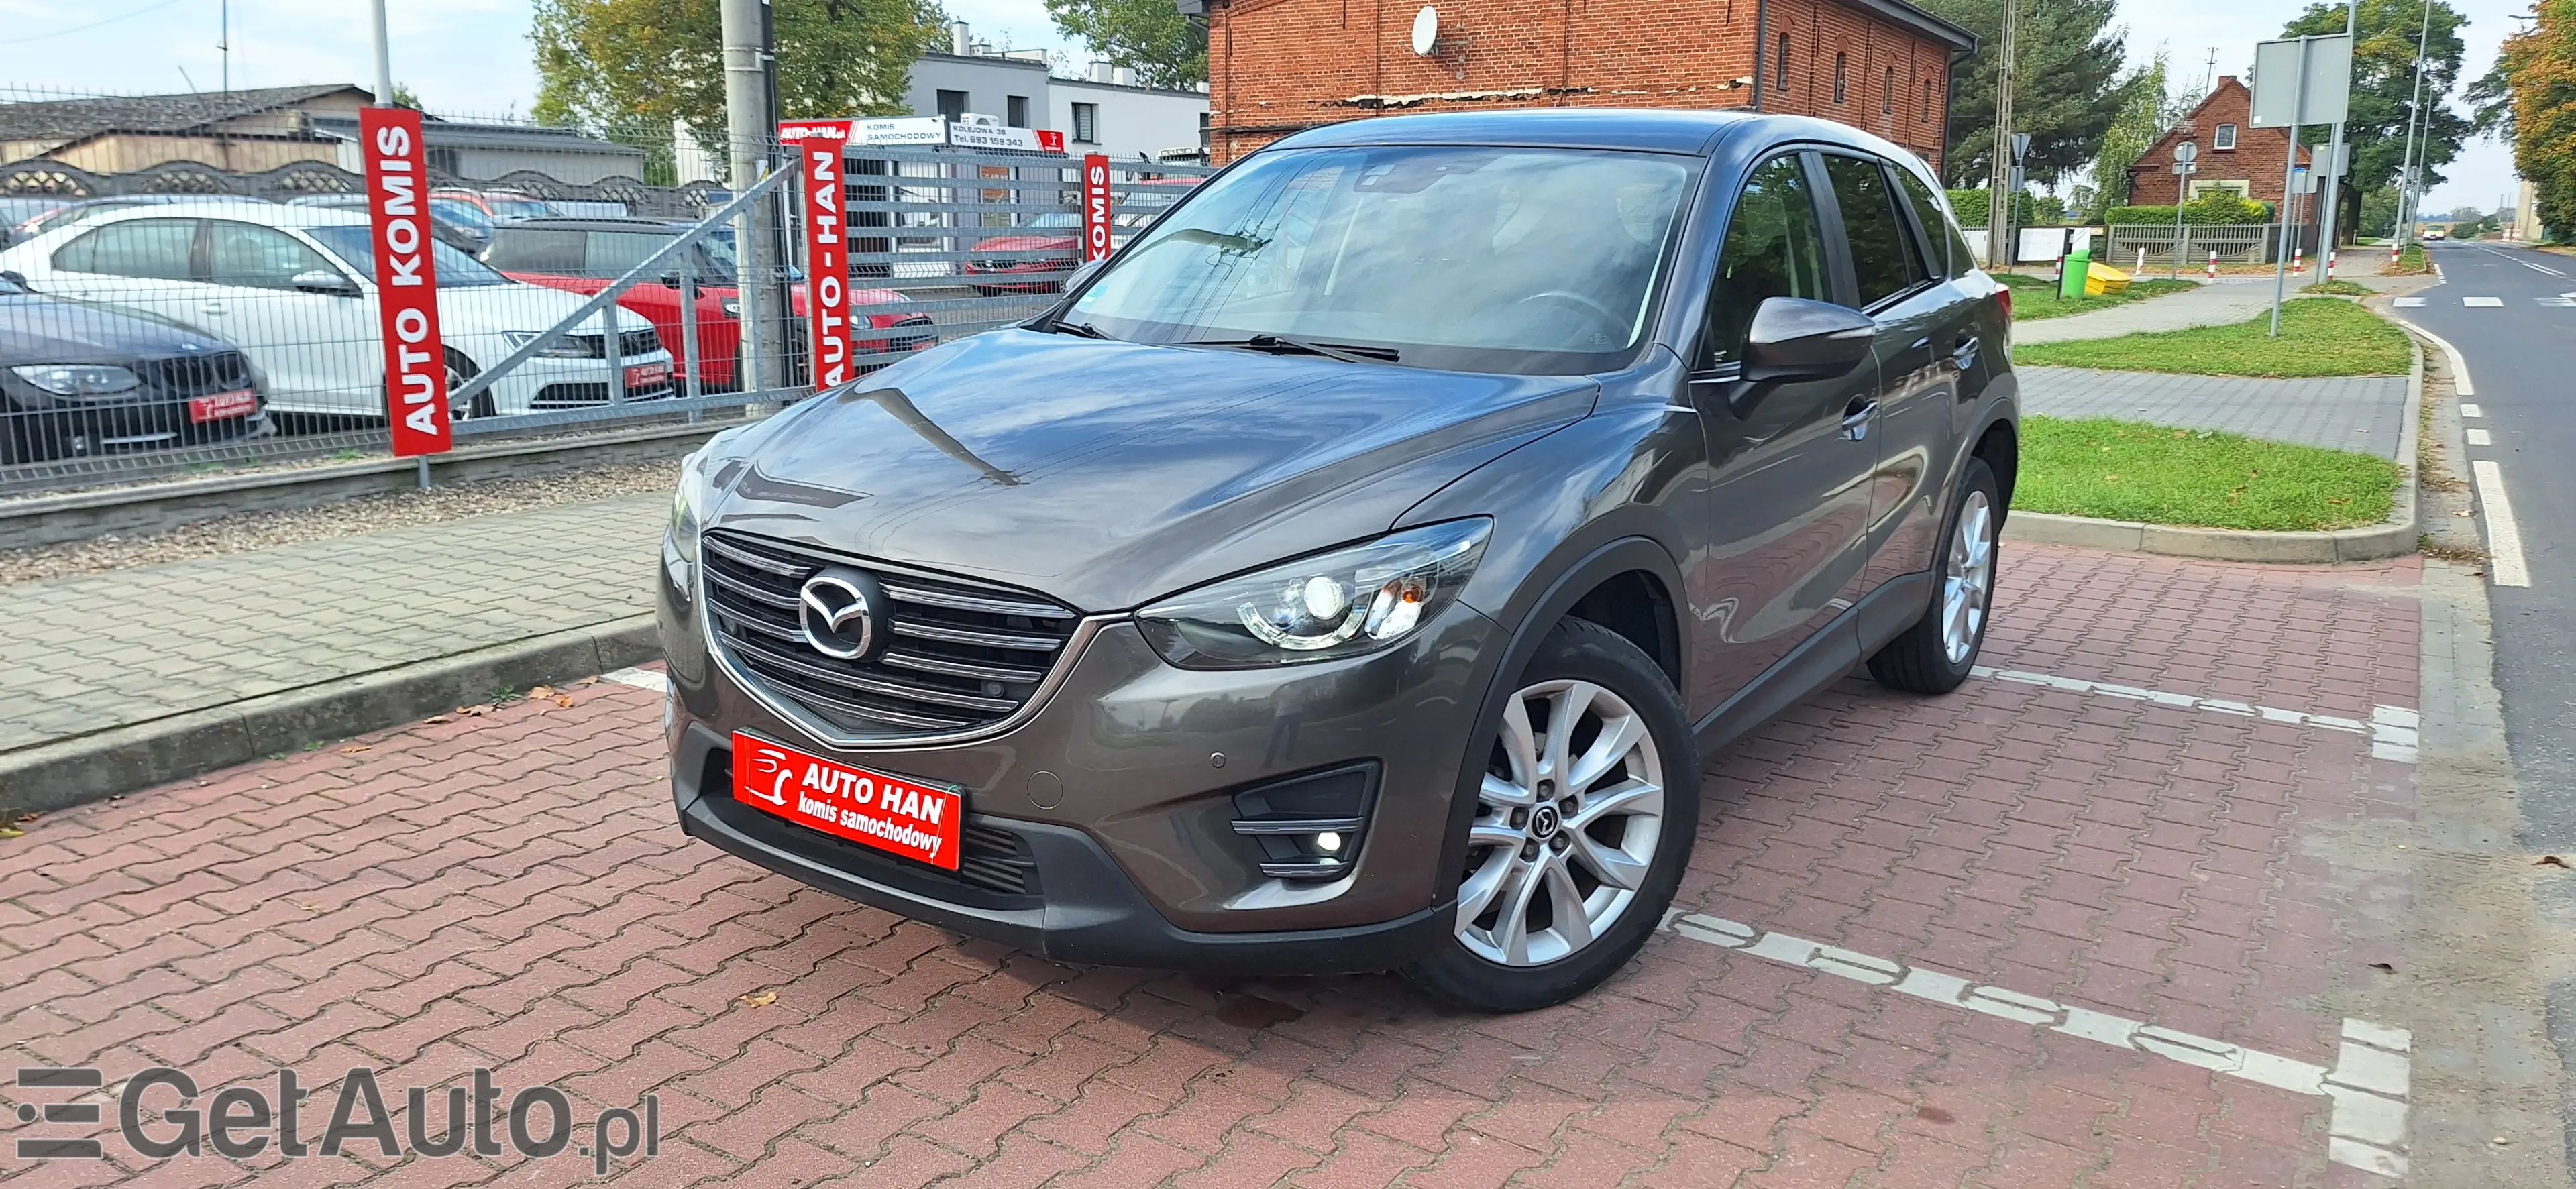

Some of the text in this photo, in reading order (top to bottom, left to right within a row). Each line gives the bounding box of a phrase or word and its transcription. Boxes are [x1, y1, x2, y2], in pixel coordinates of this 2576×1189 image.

[867, 132, 942, 141] SAMOCHODOWY
[953, 125, 994, 135] KOLEJOWA
[954, 135, 969, 143] Tel.
[989, 137, 1005, 146] 159
[1006, 139, 1023, 147] 343
[1091, 166, 1106, 261] KOMIS
[376, 125, 438, 435] AUTO KOMIS
[802, 762, 944, 824] AUTO HAN
[798, 791, 943, 859] komis samochodowy
